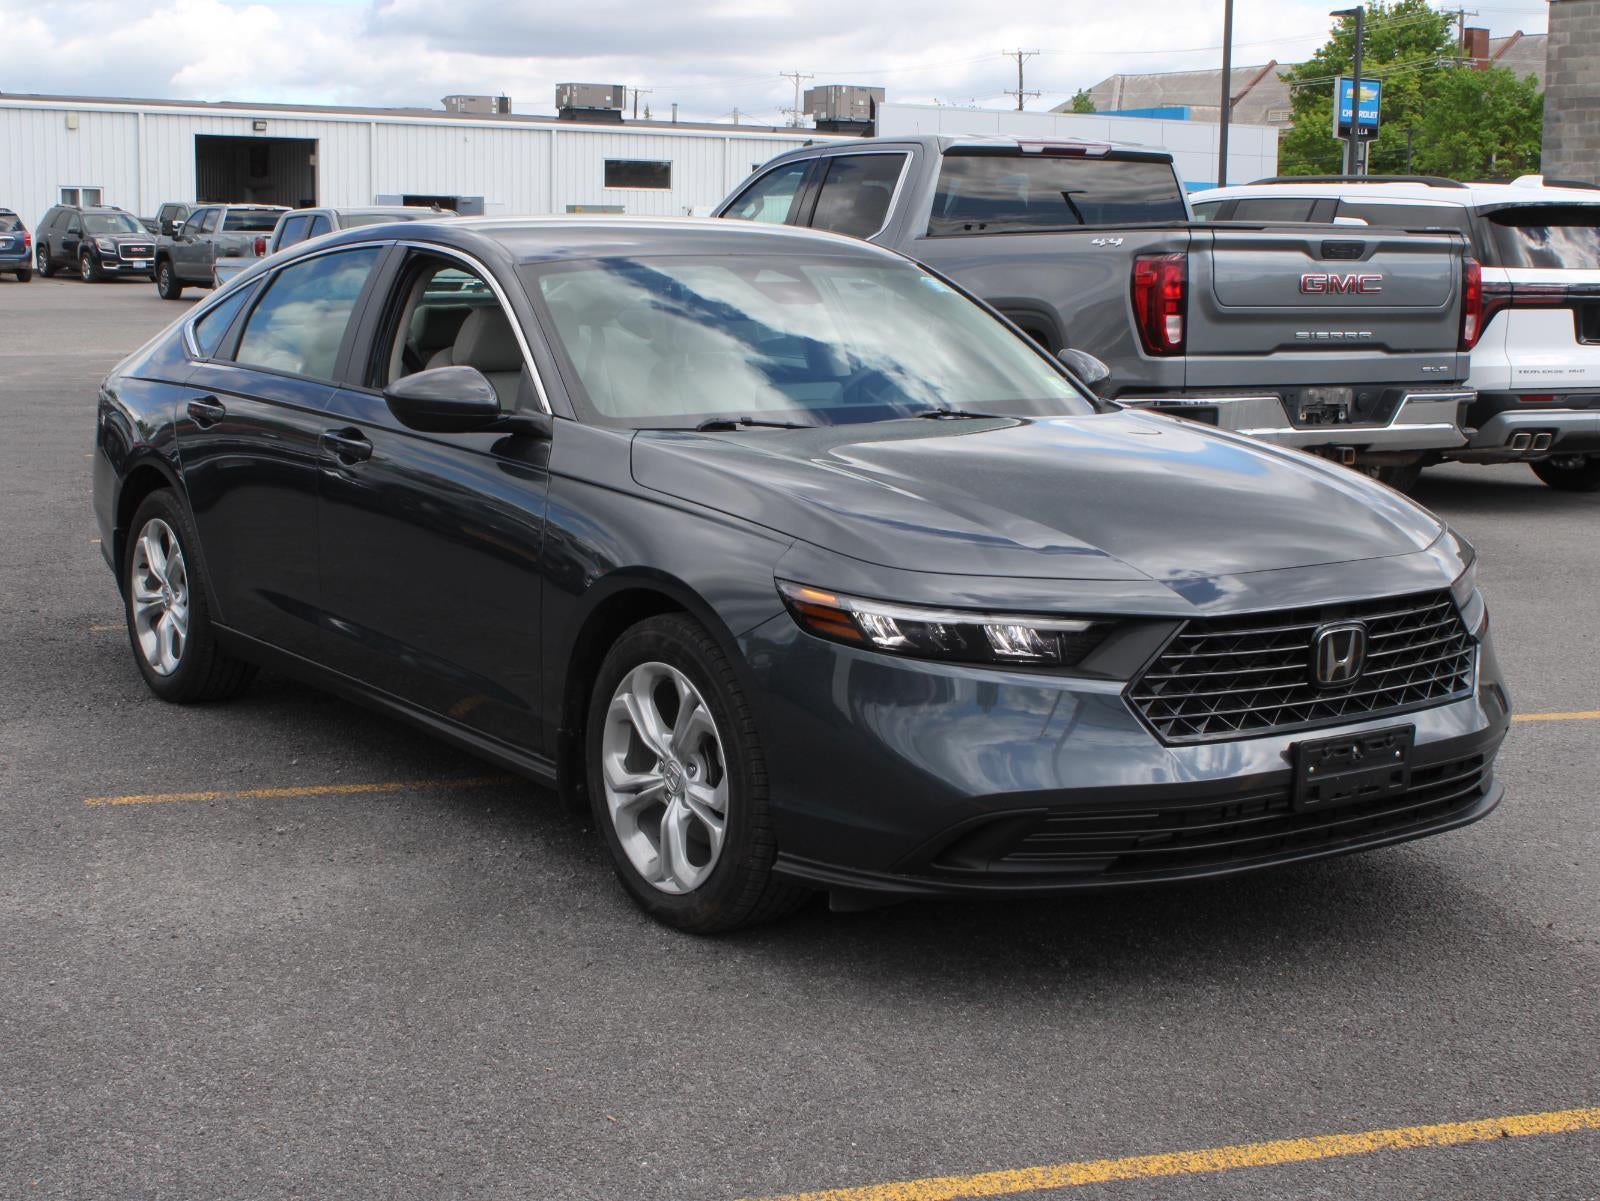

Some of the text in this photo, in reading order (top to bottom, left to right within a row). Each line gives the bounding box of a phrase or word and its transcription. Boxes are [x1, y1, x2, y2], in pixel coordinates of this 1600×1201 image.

[1342, 109, 1378, 118] CHROLET
[1300, 274, 1383, 294] GMC
[1295, 331, 1372, 340] SIERRA
